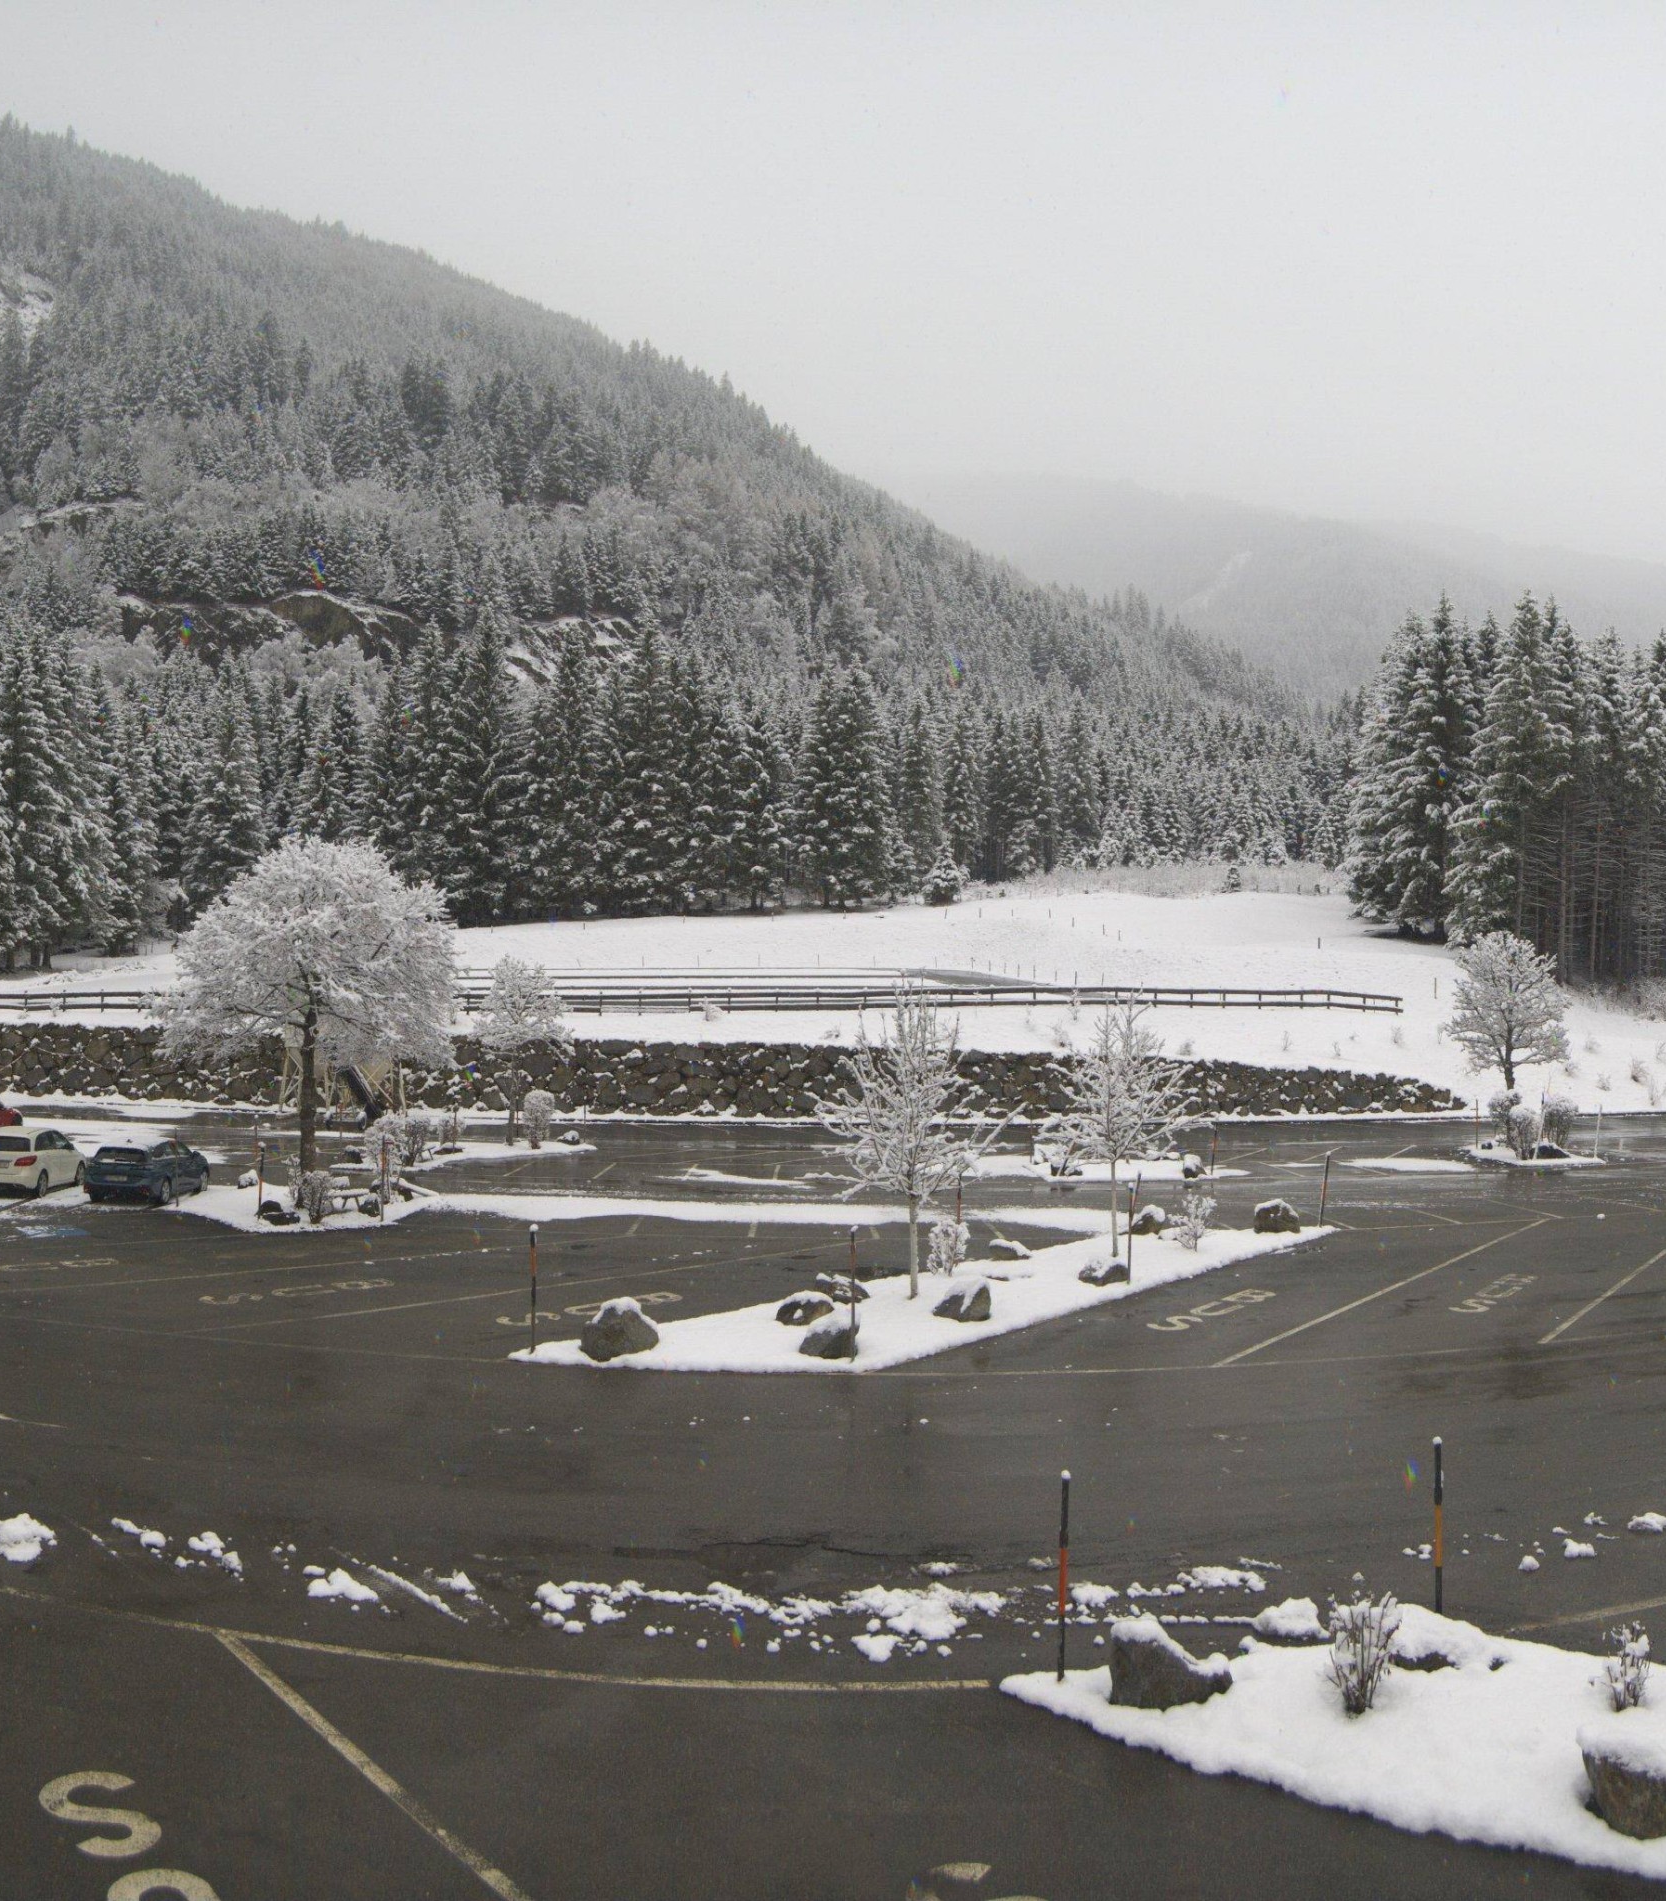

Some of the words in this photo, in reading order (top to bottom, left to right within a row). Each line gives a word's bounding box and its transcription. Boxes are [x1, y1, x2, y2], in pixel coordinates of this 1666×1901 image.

[198, 1277, 395, 1305] BUS
[1146, 1288, 1277, 1331] BUS
[1447, 1273, 1538, 1313] BUS
